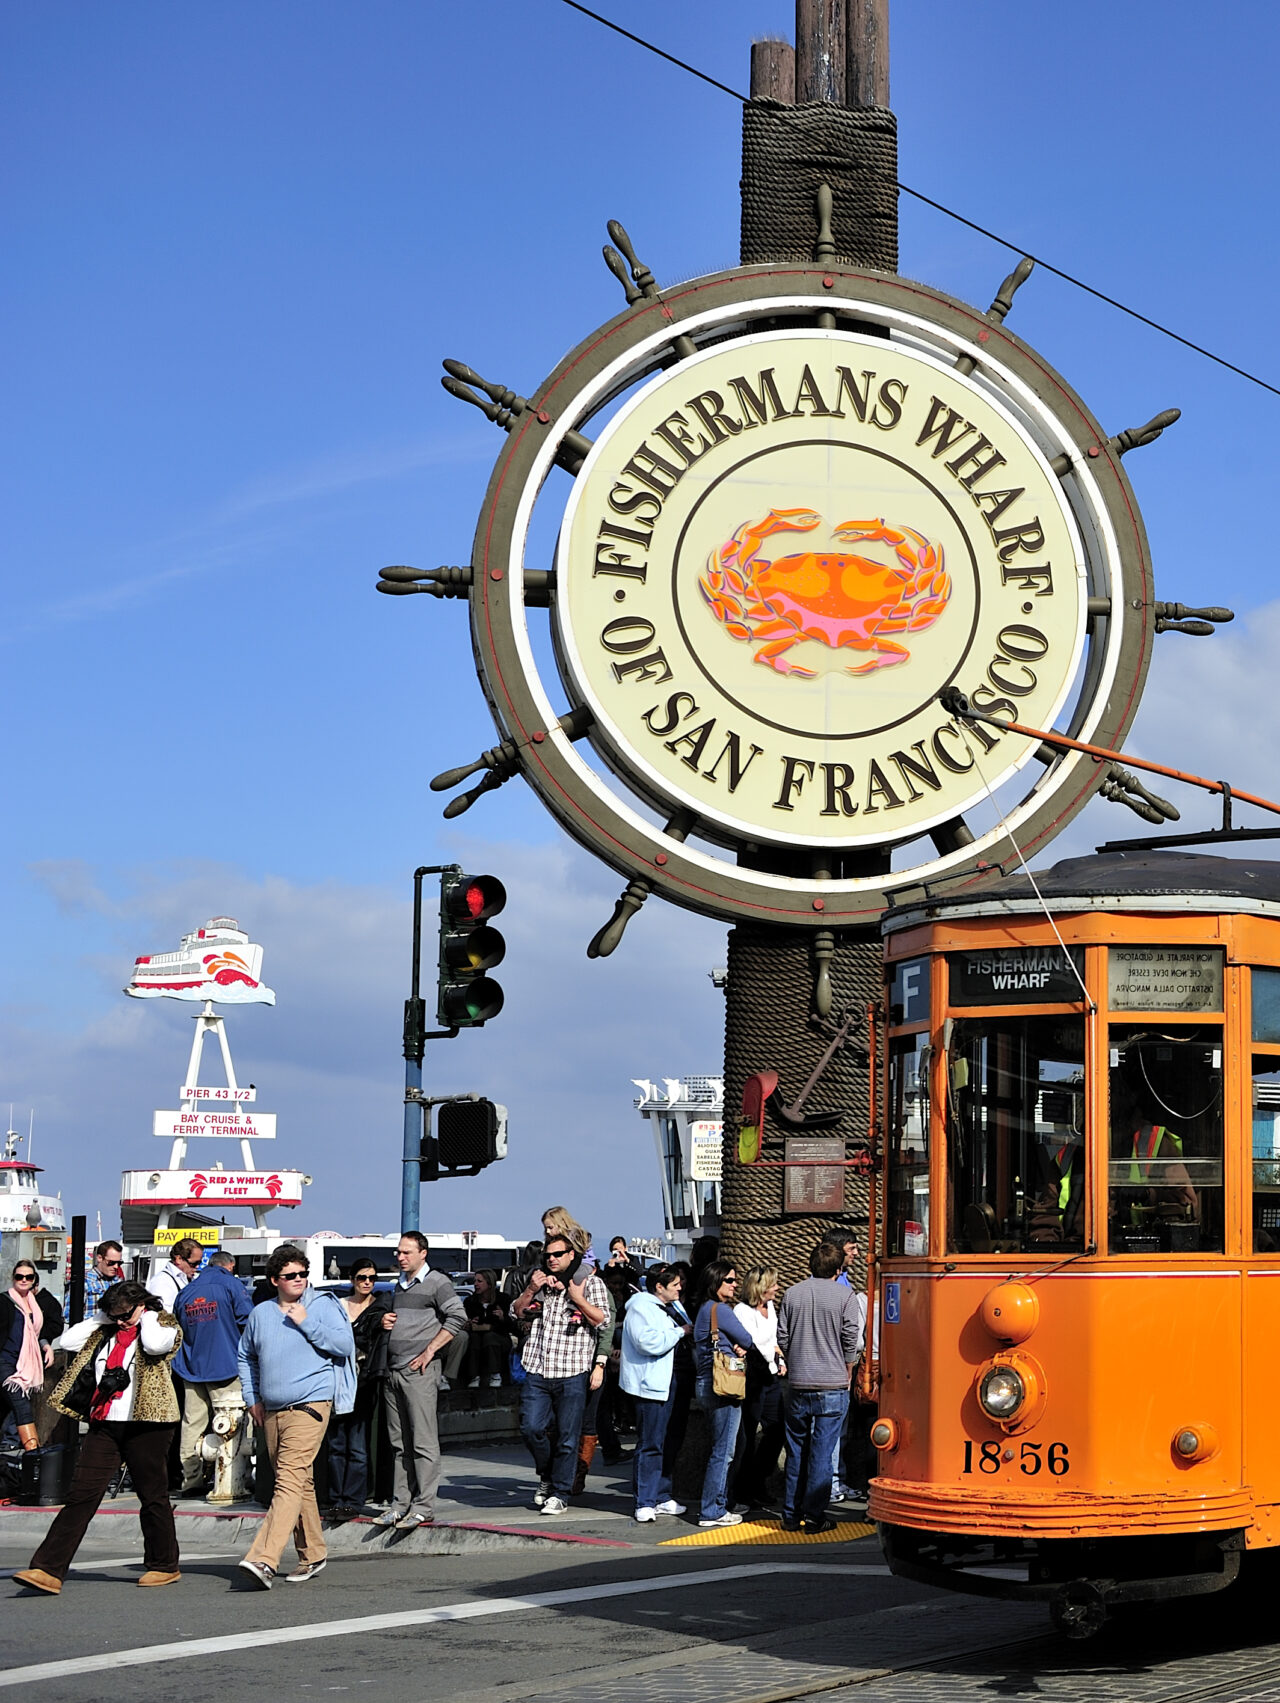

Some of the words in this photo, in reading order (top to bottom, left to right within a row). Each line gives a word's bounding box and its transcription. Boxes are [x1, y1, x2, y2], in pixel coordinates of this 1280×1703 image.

[592, 363, 909, 584] FISHERMANS
[914, 395, 1054, 598] WHARF
[600, 615, 674, 684] OF
[641, 691, 764, 793] SAN
[773, 623, 1048, 816] FRANCISCO
[967, 957, 1074, 975] FISHERMAN'S
[992, 973, 1051, 990] WHARF
[902, 965, 921, 1019] F
[186, 1088, 210, 1099] PIER
[215, 1089, 228, 1099] 43
[234, 1090, 250, 1100] 1/2
[181, 1114, 200, 1124] BAY
[204, 1114, 240, 1125] CRUISE
[245, 1115, 252, 1125] &
[173, 1125, 205, 1135] FERRY
[210, 1126, 259, 1136] TERMINAL
[209, 1176, 228, 1185] RED
[228, 1176, 234, 1185] &
[236, 1176, 265, 1185] WHITE
[223, 1187, 248, 1195] FLEET
[157, 1231, 178, 1241] PAY
[183, 1231, 216, 1241] HERE
